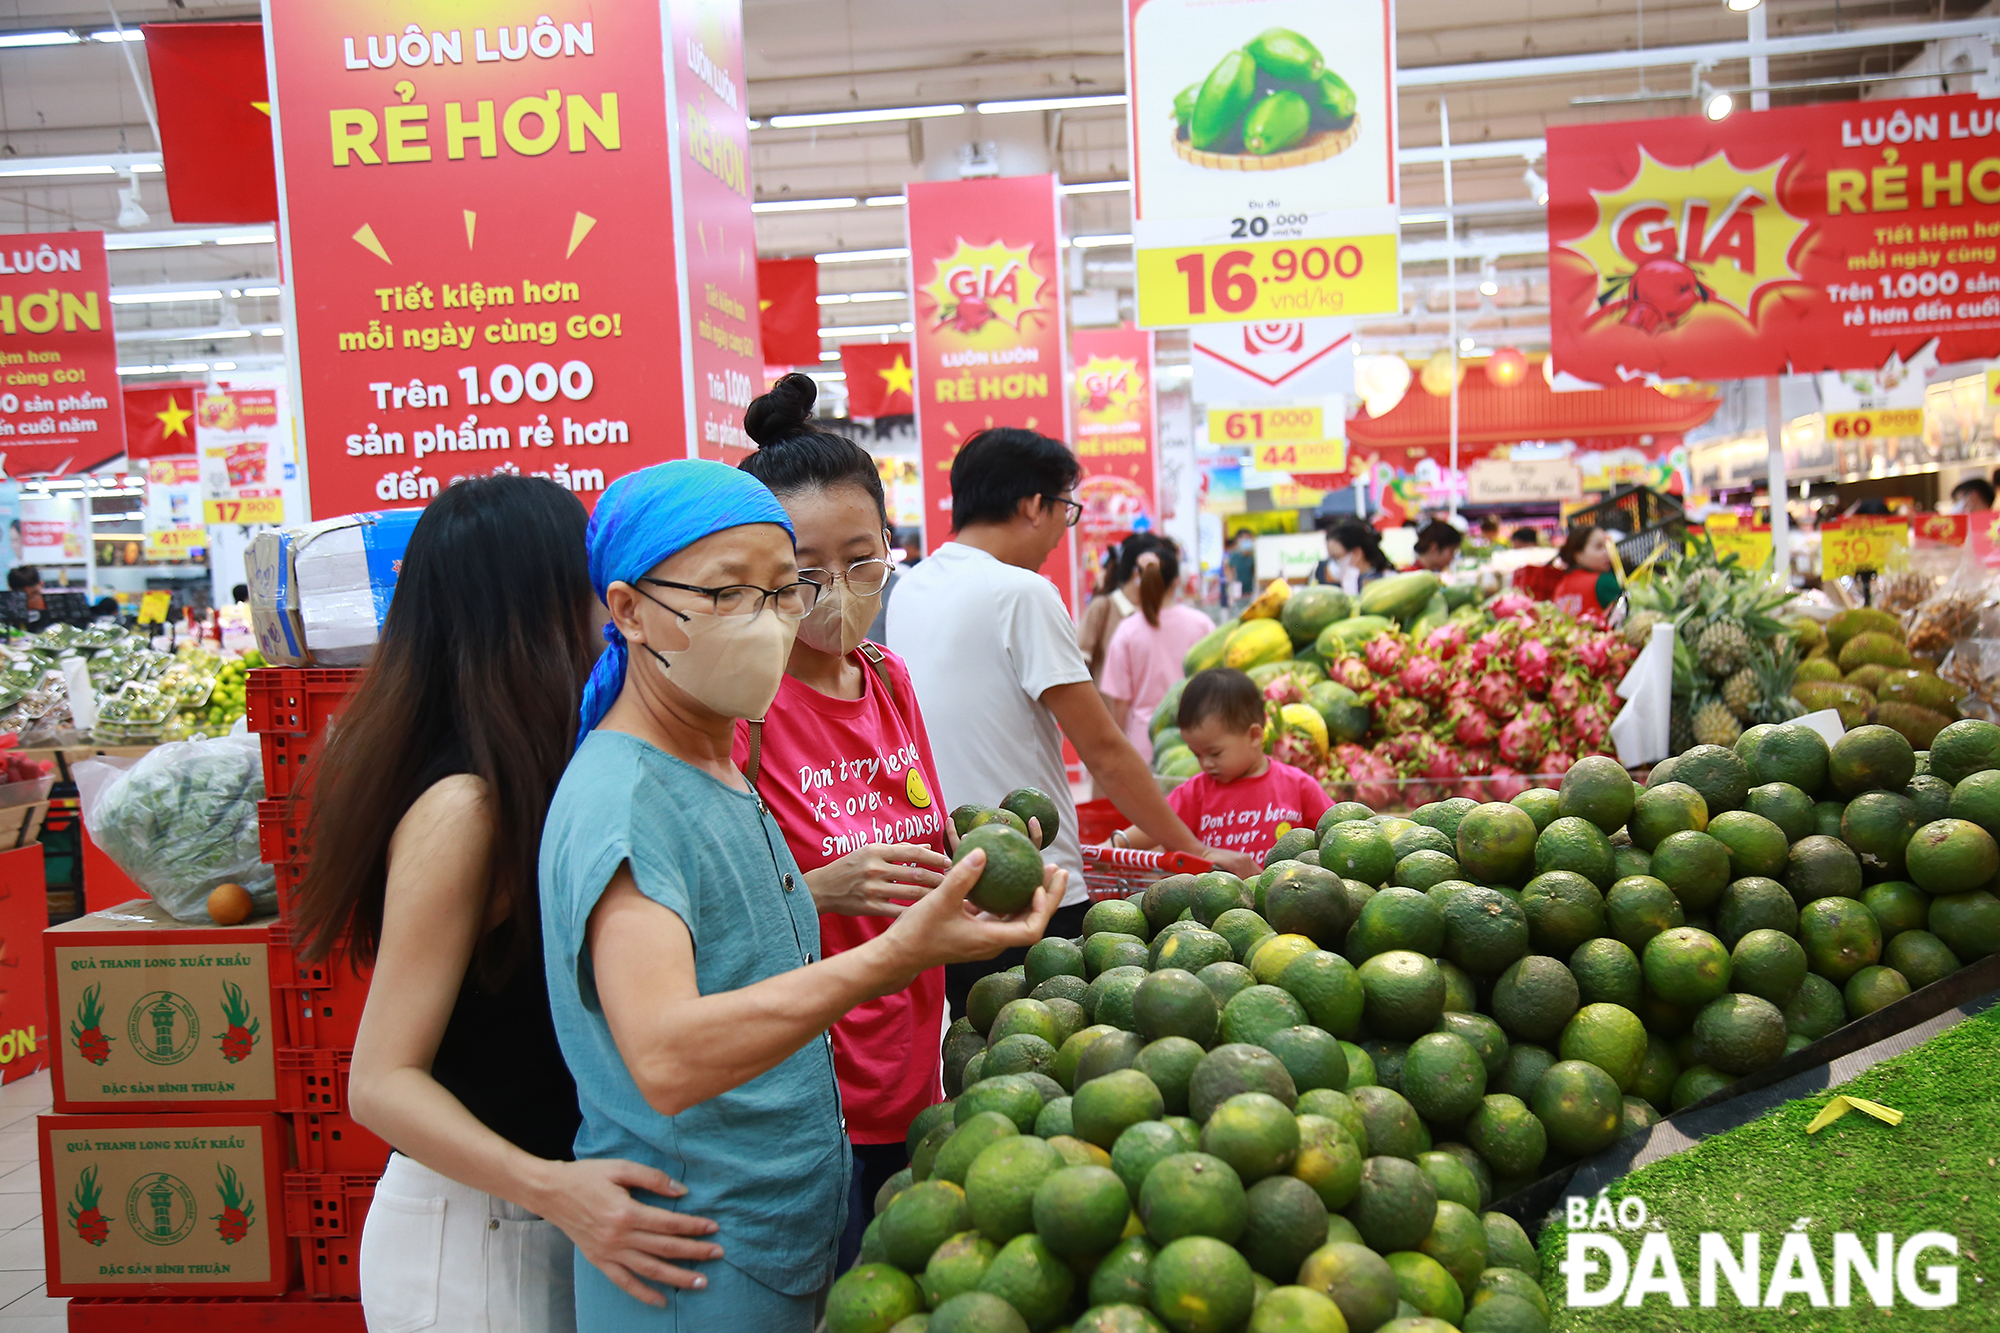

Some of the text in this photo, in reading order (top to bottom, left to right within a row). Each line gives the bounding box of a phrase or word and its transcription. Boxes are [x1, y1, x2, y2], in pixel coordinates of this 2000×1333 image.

[344, 15, 595, 70] LUÔN LUÔN
[687, 37, 738, 112] LUÔN LUÔN
[329, 80, 622, 168] RẺ HƠN
[687, 91, 711, 173] RẺ
[1842, 108, 1939, 147] LUÔN
[1827, 146, 1909, 217] RẺ
[1610, 185, 1768, 278] GIÁ
[1874, 222, 1914, 246] Tiết
[1919, 220, 1969, 245] kiệm
[0, 243, 82, 275] LUÔN
[1848, 244, 1997, 271] mỗi ngày cùng
[375, 279, 580, 313] Tiết kiệm hơn
[944, 258, 1021, 304] GIÁ
[1826, 281, 1874, 303] Trên
[1878, 269, 1960, 300] 1.000
[1270, 287, 1344, 312] vnd/kg
[1843, 303, 1865, 327] rẻ
[1869, 306, 1909, 325] hơn
[1913, 298, 1953, 322] đến
[339, 313, 623, 352] mỗi ngày cùng GO!
[27, 349, 61, 364] hơn
[941, 345, 1039, 368] LUÔN LUÔN
[6, 370, 49, 387] cùng
[53, 369, 86, 384] GO!
[369, 360, 595, 410] Trên 1.000
[707, 372, 727, 403] Trên
[935, 368, 1049, 404] RẺ HƠN
[23, 394, 55, 413] sản
[58, 390, 108, 413] phẩm
[18, 416, 56, 435] cuối
[59, 418, 98, 433] năm
[346, 414, 630, 459] sản phẩm rẻ hơn
[705, 411, 720, 443] sản
[719, 413, 741, 449] phẩm
[376, 466, 440, 502] đến
[799, 756, 849, 795] Don't
[849, 757, 880, 785] cry
[811, 794, 841, 823] it's
[1201, 809, 1236, 832] Don't
[1238, 810, 1261, 827] cry
[822, 811, 941, 857] smile because
[1202, 831, 1222, 848] it's
[71, 952, 252, 971] QUẢ THANH LONG XUẤT KHẨU
[102, 1081, 236, 1096] ĐẶC SẢN BÌNH THUẬN
[67, 1135, 246, 1153] QUẢ THANH LONG XUẤT KHẨU
[99, 1262, 231, 1276] ĐẶC SẢN BÌNH THUẬN
